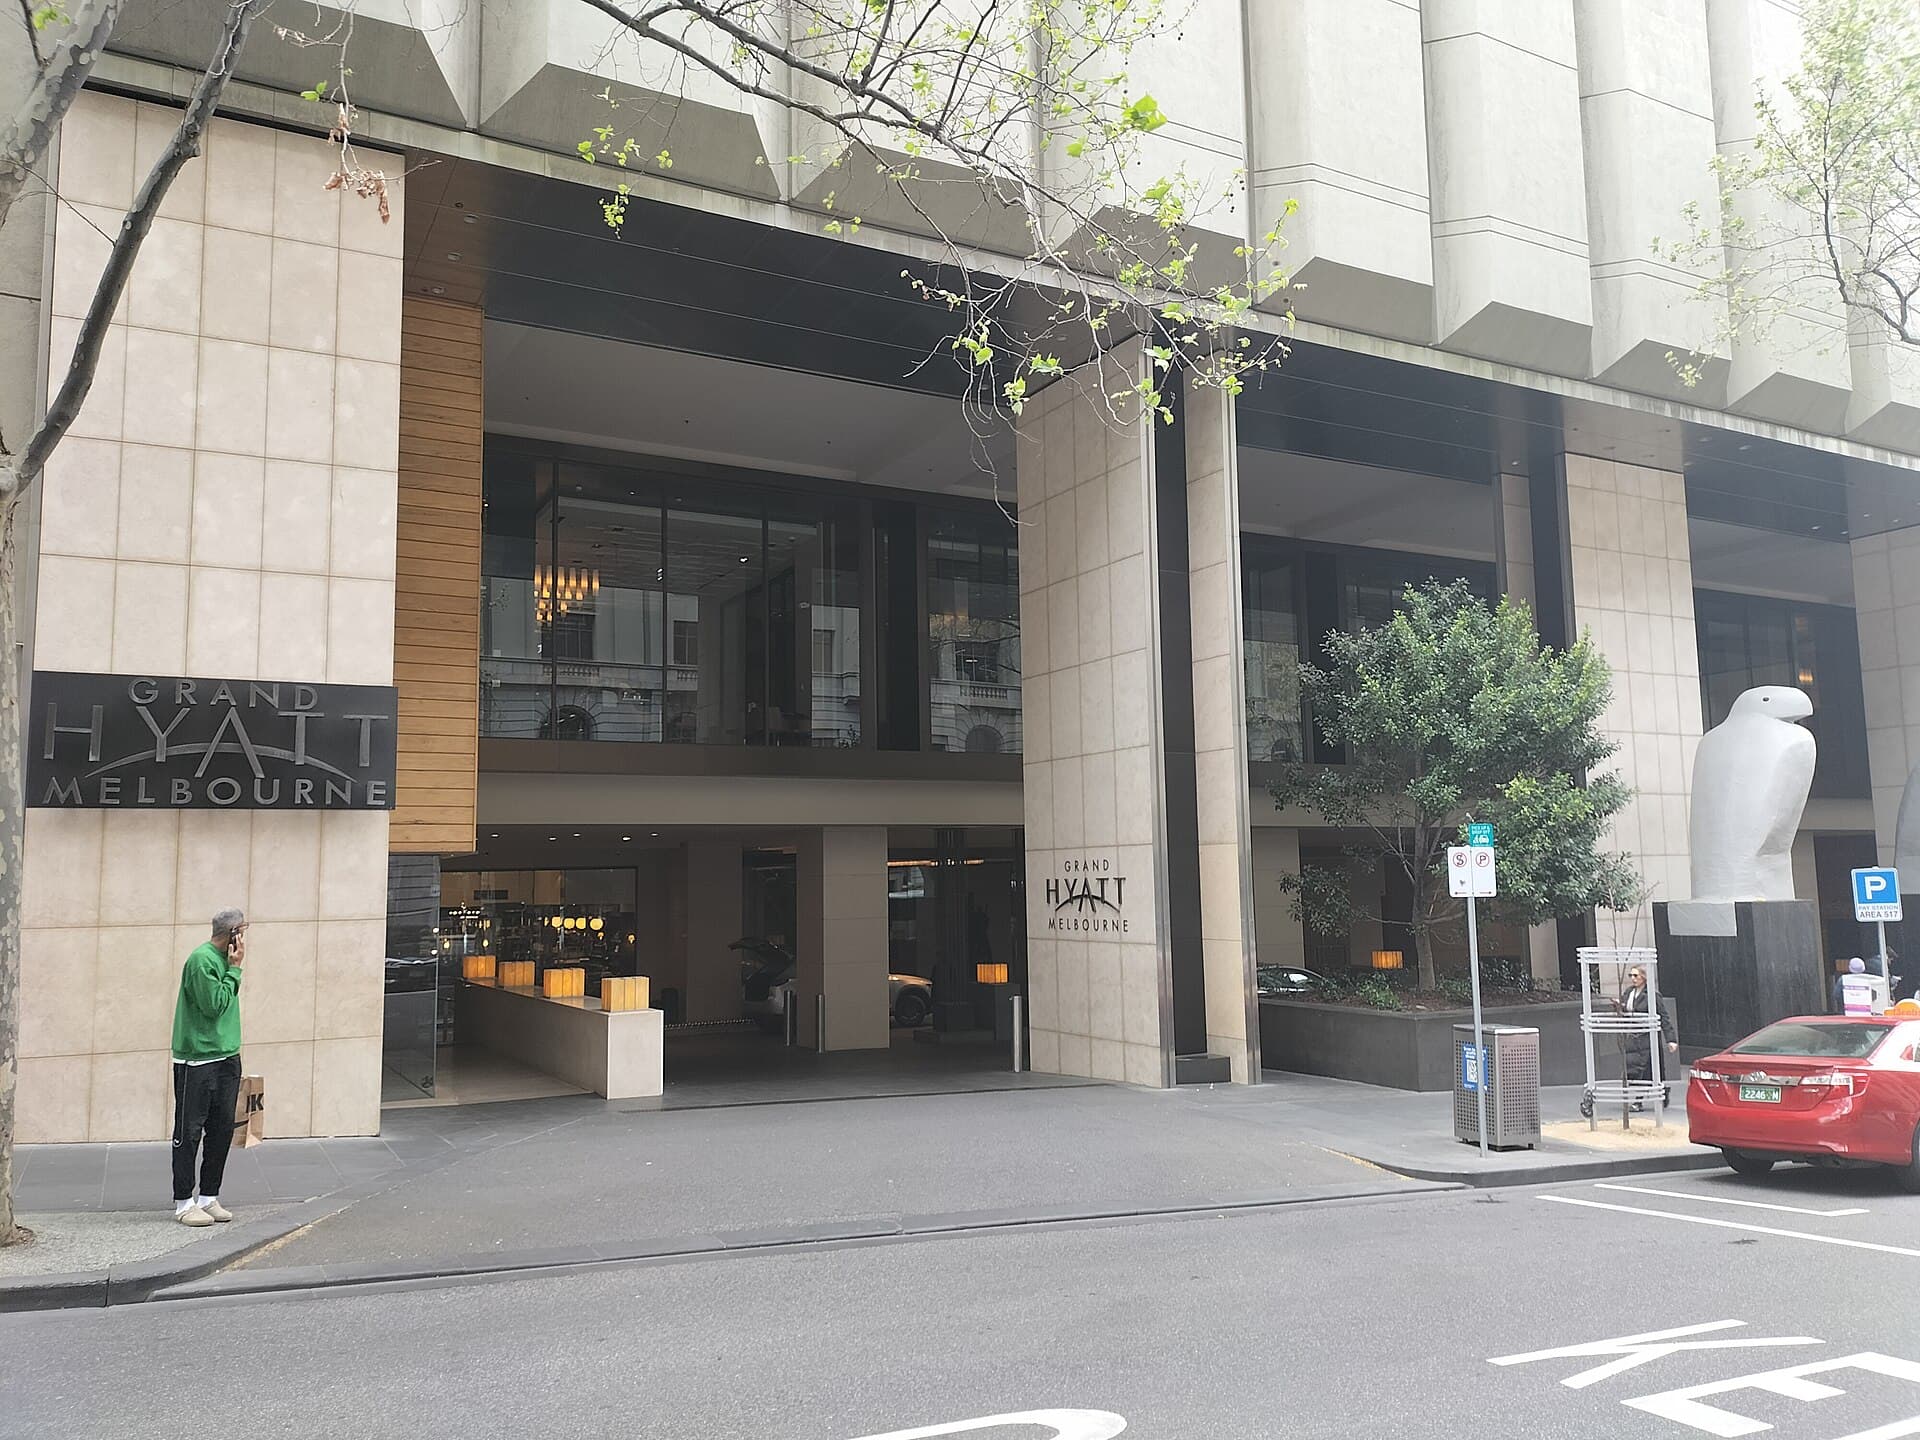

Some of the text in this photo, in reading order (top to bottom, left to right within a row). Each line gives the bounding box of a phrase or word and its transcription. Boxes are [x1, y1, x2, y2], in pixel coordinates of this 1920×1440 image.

[128, 678, 319, 710] GRAND
[43, 702, 390, 779] HYATT
[42, 776, 387, 806] MELBOURNE
[1064, 859, 1110, 872] GRAND
[1046, 877, 1127, 913] HYATT
[1864, 876, 1887, 900] P
[1048, 917, 1129, 932] MELBOURNE
[1745, 1090, 1766, 1099] 2246
